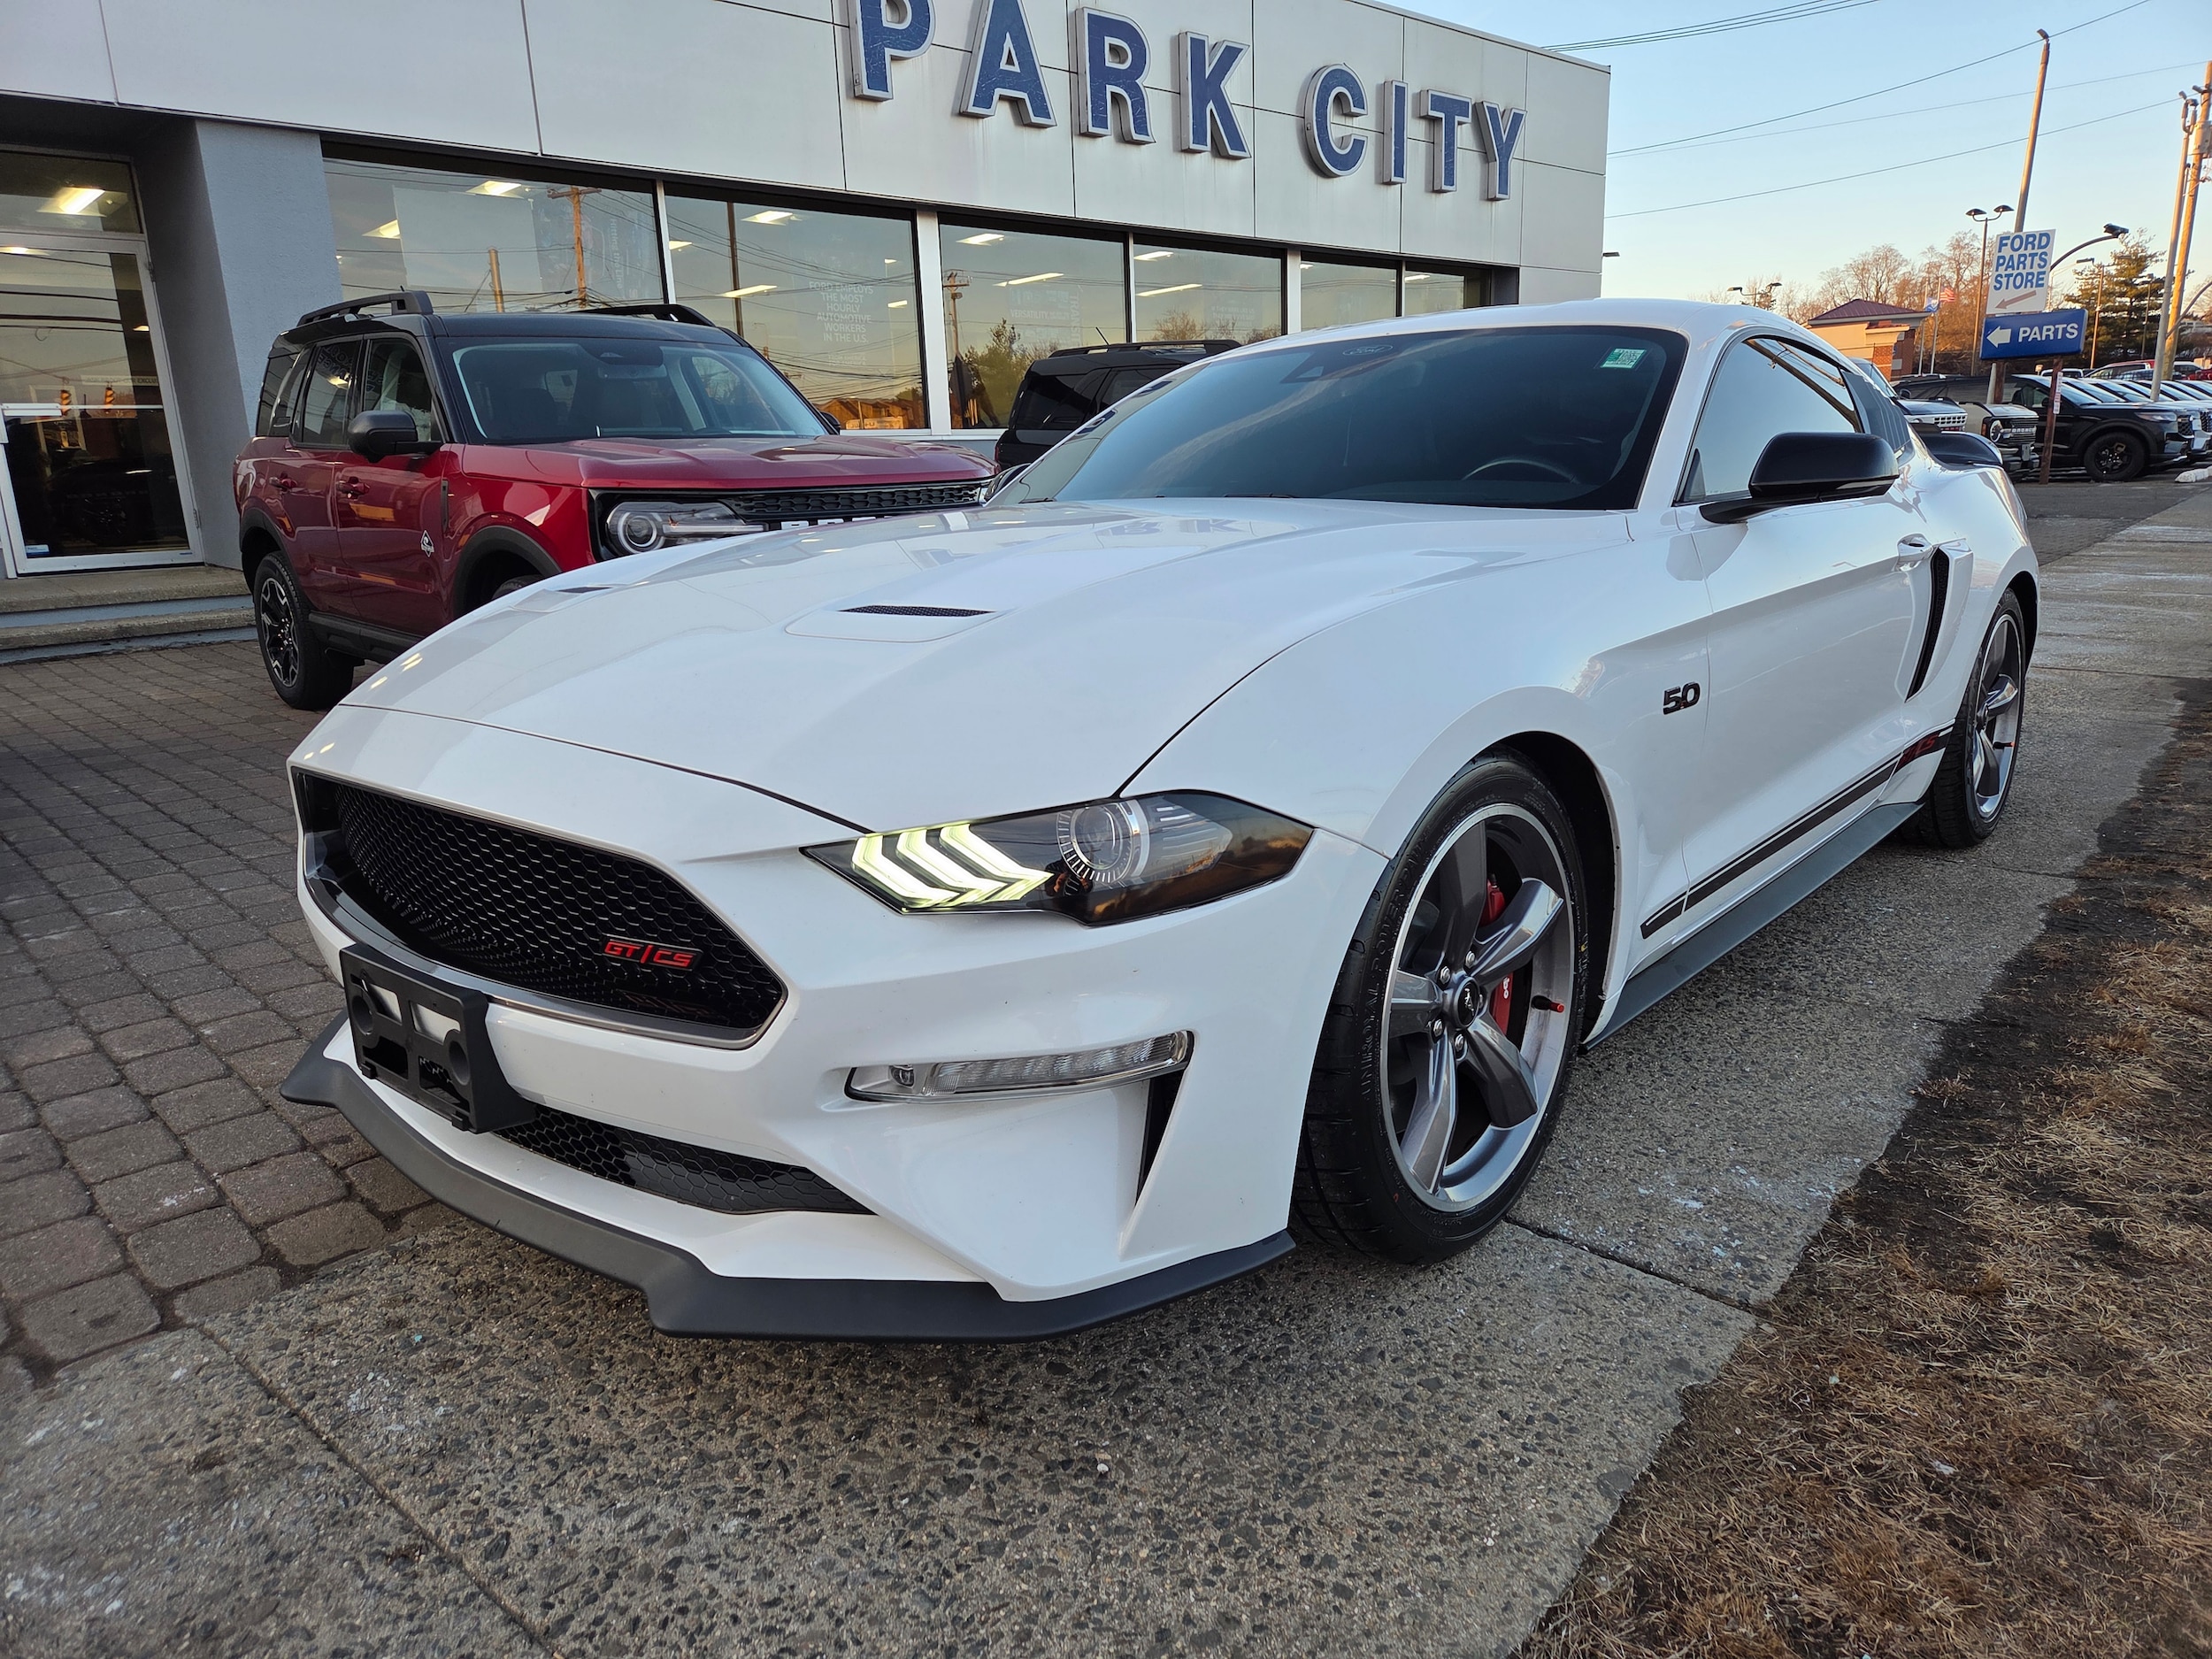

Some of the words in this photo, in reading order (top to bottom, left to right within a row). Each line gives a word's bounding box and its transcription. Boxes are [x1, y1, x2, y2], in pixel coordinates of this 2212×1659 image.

[847, 0, 1252, 159] PARK
[1304, 63, 1527, 202] CITY
[1997, 233, 2051, 253] FORD
[1994, 251, 2049, 273] PARTS
[809, 280, 833, 292] FORD
[835, 283, 874, 295] EMPLOYS
[1993, 271, 2047, 291] STORE
[820, 292, 838, 302] THE
[840, 294, 864, 303] MOST
[816, 312, 872, 324] AUTOMOTIVE
[826, 303, 861, 313] HOURLY
[824, 322, 867, 334] WORKERS
[1068, 292, 1083, 346] TRANSIT
[823, 332, 833, 342] IN
[833, 333, 852, 343] THE
[853, 334, 870, 344] U.S.
[2017, 322, 2079, 343] PARTS
[1663, 680, 1701, 715] 5.0
